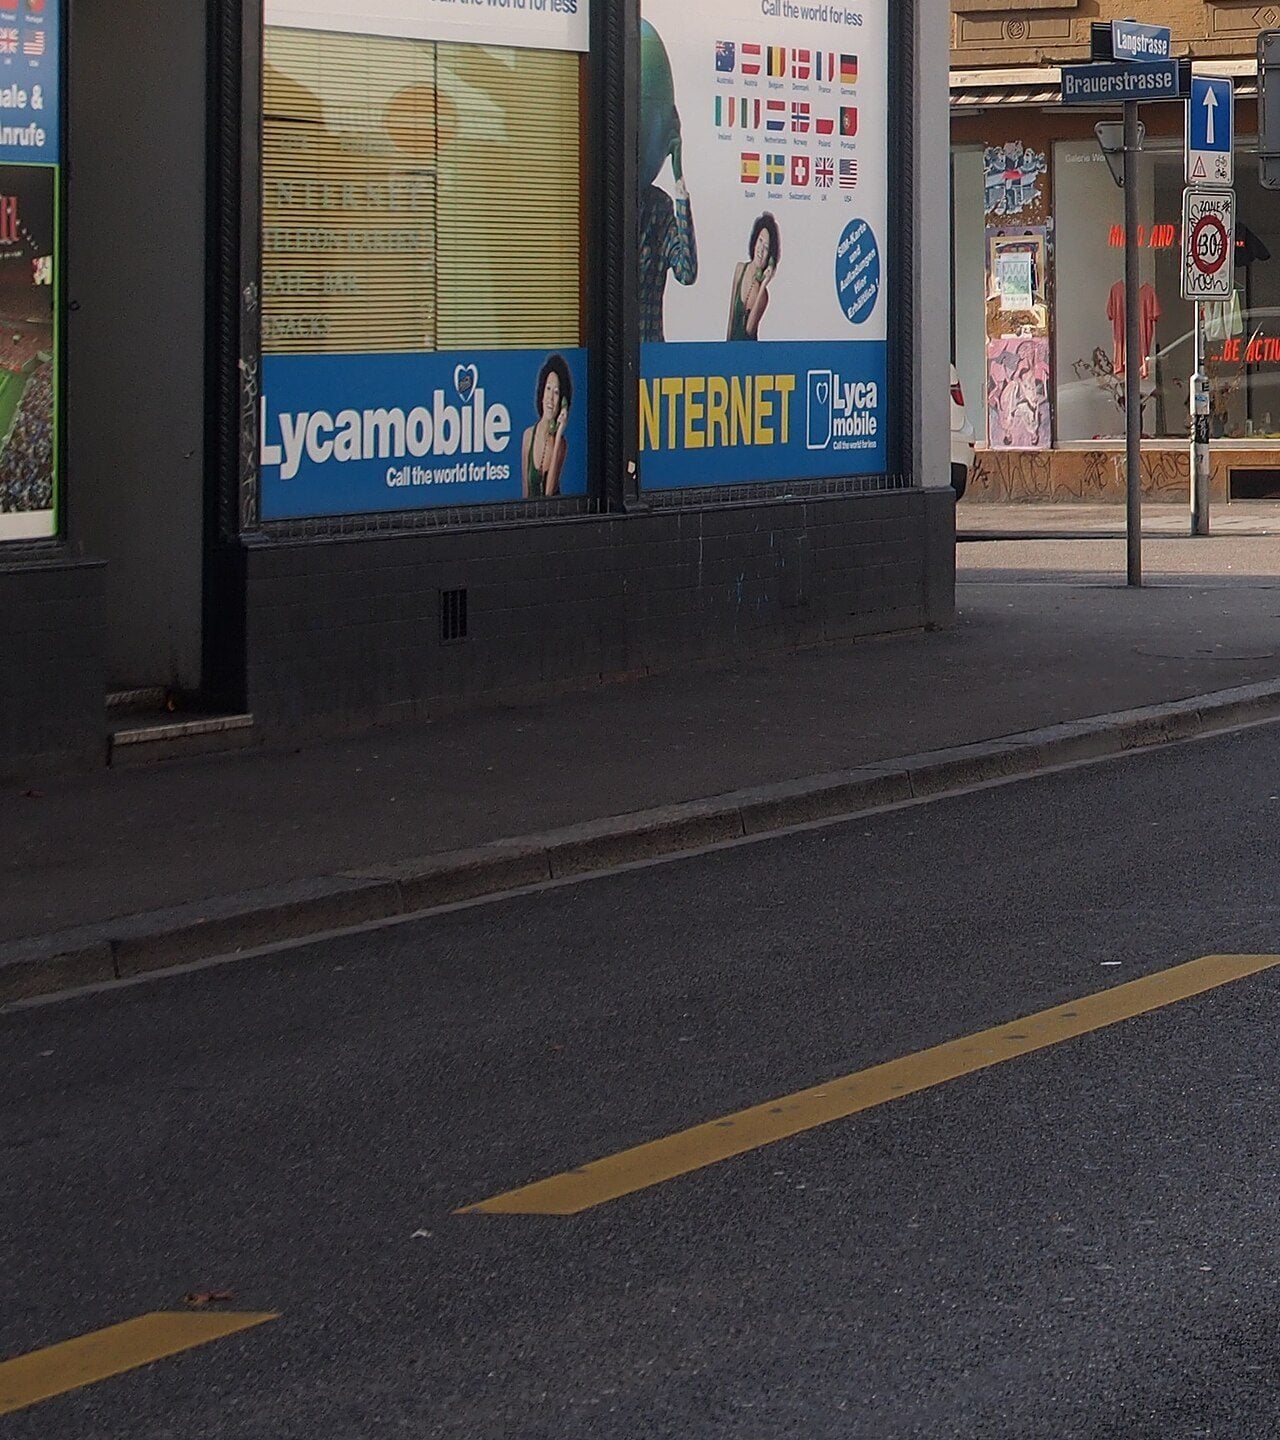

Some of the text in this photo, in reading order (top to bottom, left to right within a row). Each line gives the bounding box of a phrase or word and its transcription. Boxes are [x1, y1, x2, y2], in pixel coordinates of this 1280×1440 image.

[783, 0, 800, 18] the
[800, 3, 828, 22] world
[829, 8, 844, 23] for
[844, 9, 863, 27] less
[1117, 29, 1168, 55] Langstrasse
[1066, 72, 1172, 94] Brauerstrasse
[31, 84, 43, 110] &
[0, 122, 46, 147] nrufe
[1198, 233, 1217, 256] 30
[833, 374, 877, 416] Lyca
[639, 374, 796, 452] NTERNET
[833, 411, 877, 437] mobile
[260, 388, 511, 480] Lycamobile
[386, 462, 510, 488] Call the world for less
